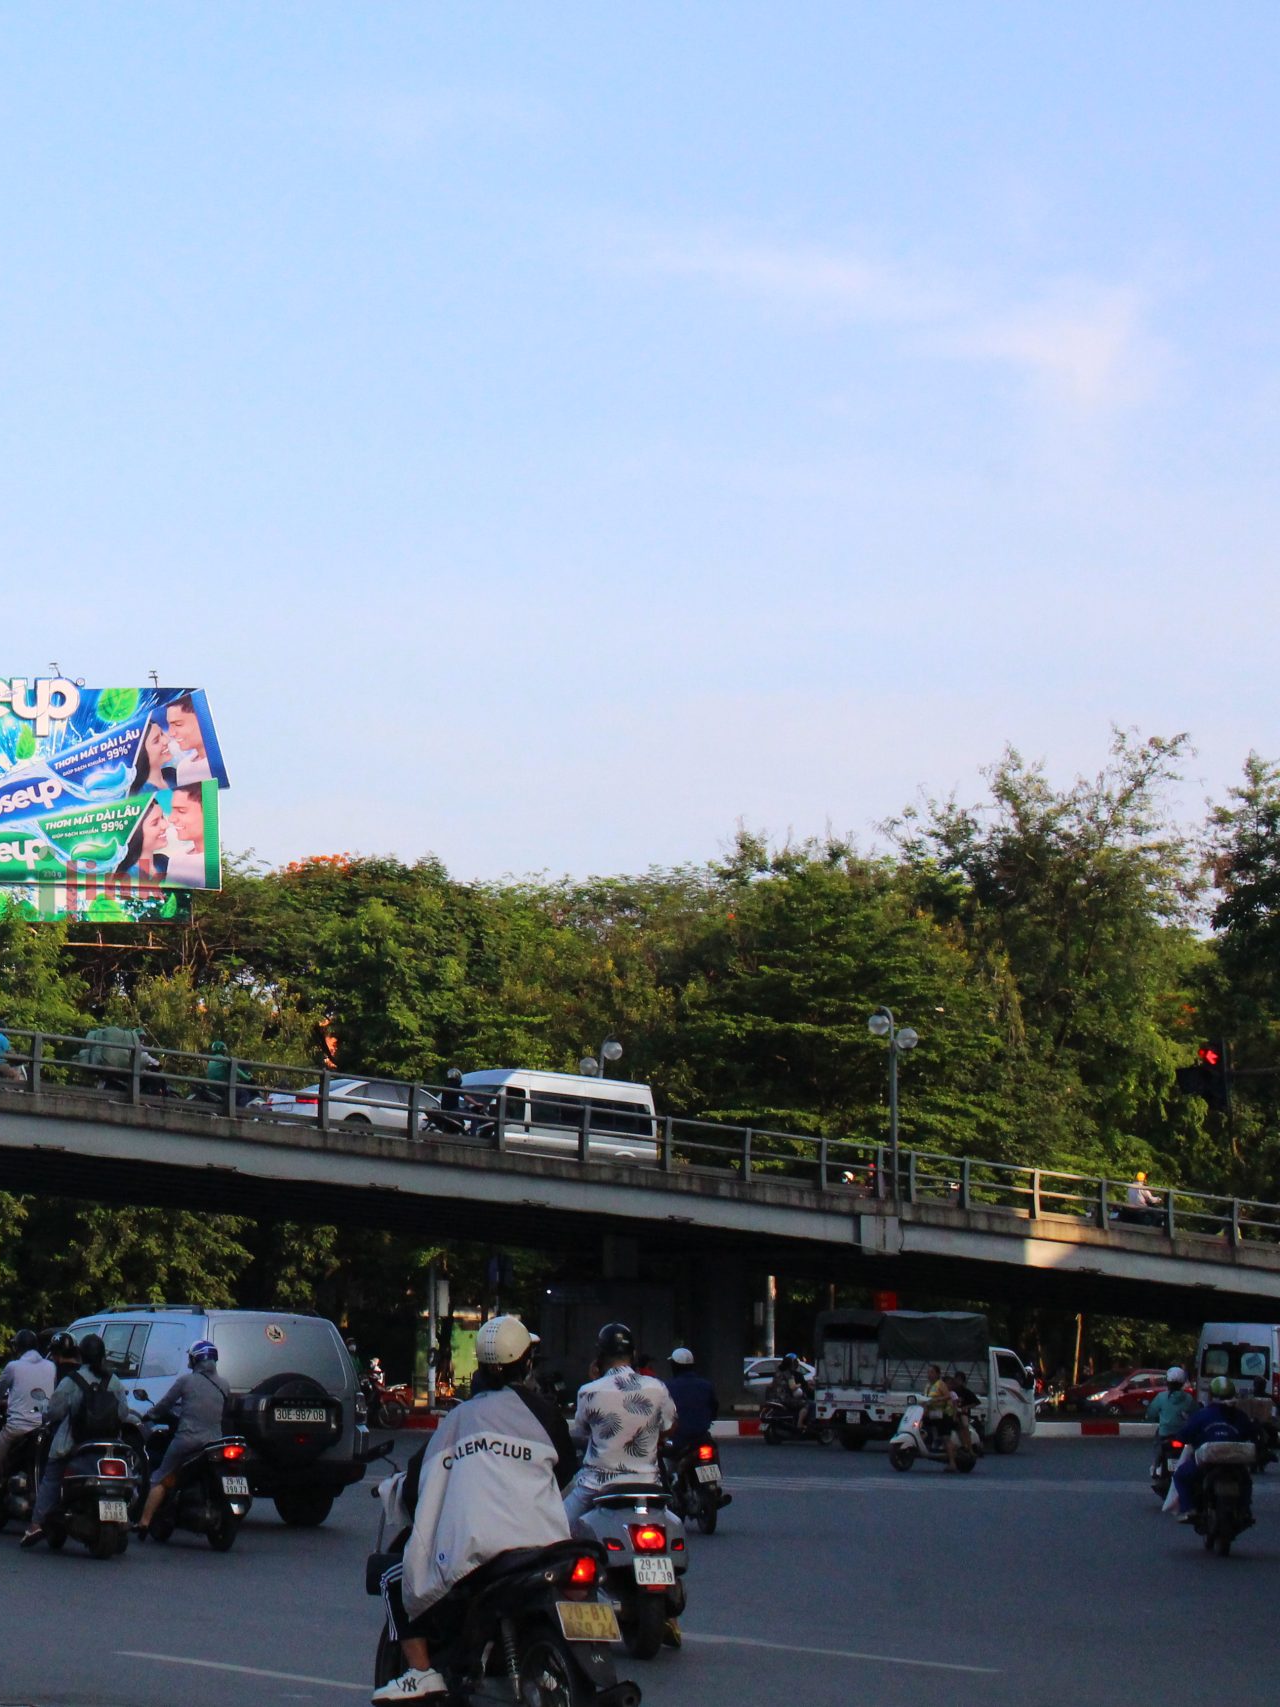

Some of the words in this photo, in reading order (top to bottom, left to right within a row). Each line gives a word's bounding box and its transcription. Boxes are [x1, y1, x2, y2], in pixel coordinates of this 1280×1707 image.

[80, 744, 99, 763] MÁT
[100, 736, 118, 752] DÀI
[118, 726, 140, 745] LÂU
[73, 813, 95, 825] MÁT
[96, 808, 116, 822] DÀI
[117, 805, 141, 819] LÂU
